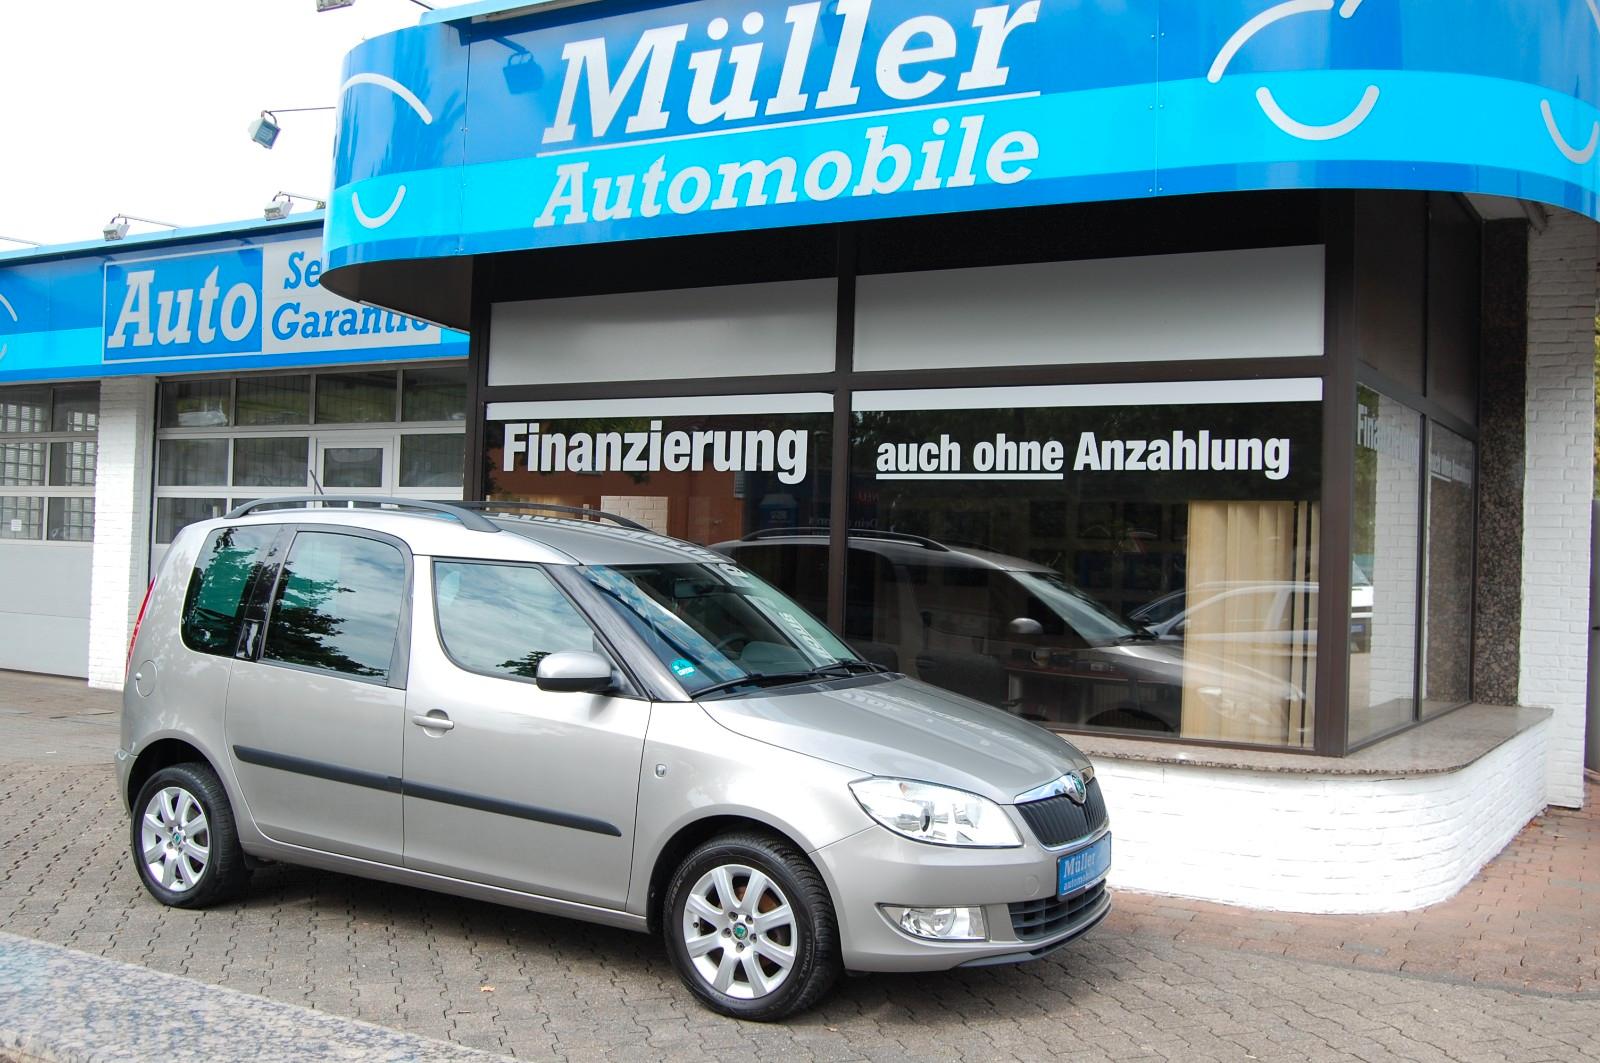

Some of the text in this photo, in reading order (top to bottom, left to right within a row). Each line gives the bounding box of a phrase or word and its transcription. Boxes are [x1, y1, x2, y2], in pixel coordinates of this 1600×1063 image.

[541, 0, 1041, 144] Müller
[533, 115, 1039, 228] Automobile
[107, 266, 257, 349] Auto
[503, 420, 809, 485] Finanzierung
[876, 430, 1291, 480] auch ohne Anzahlung
